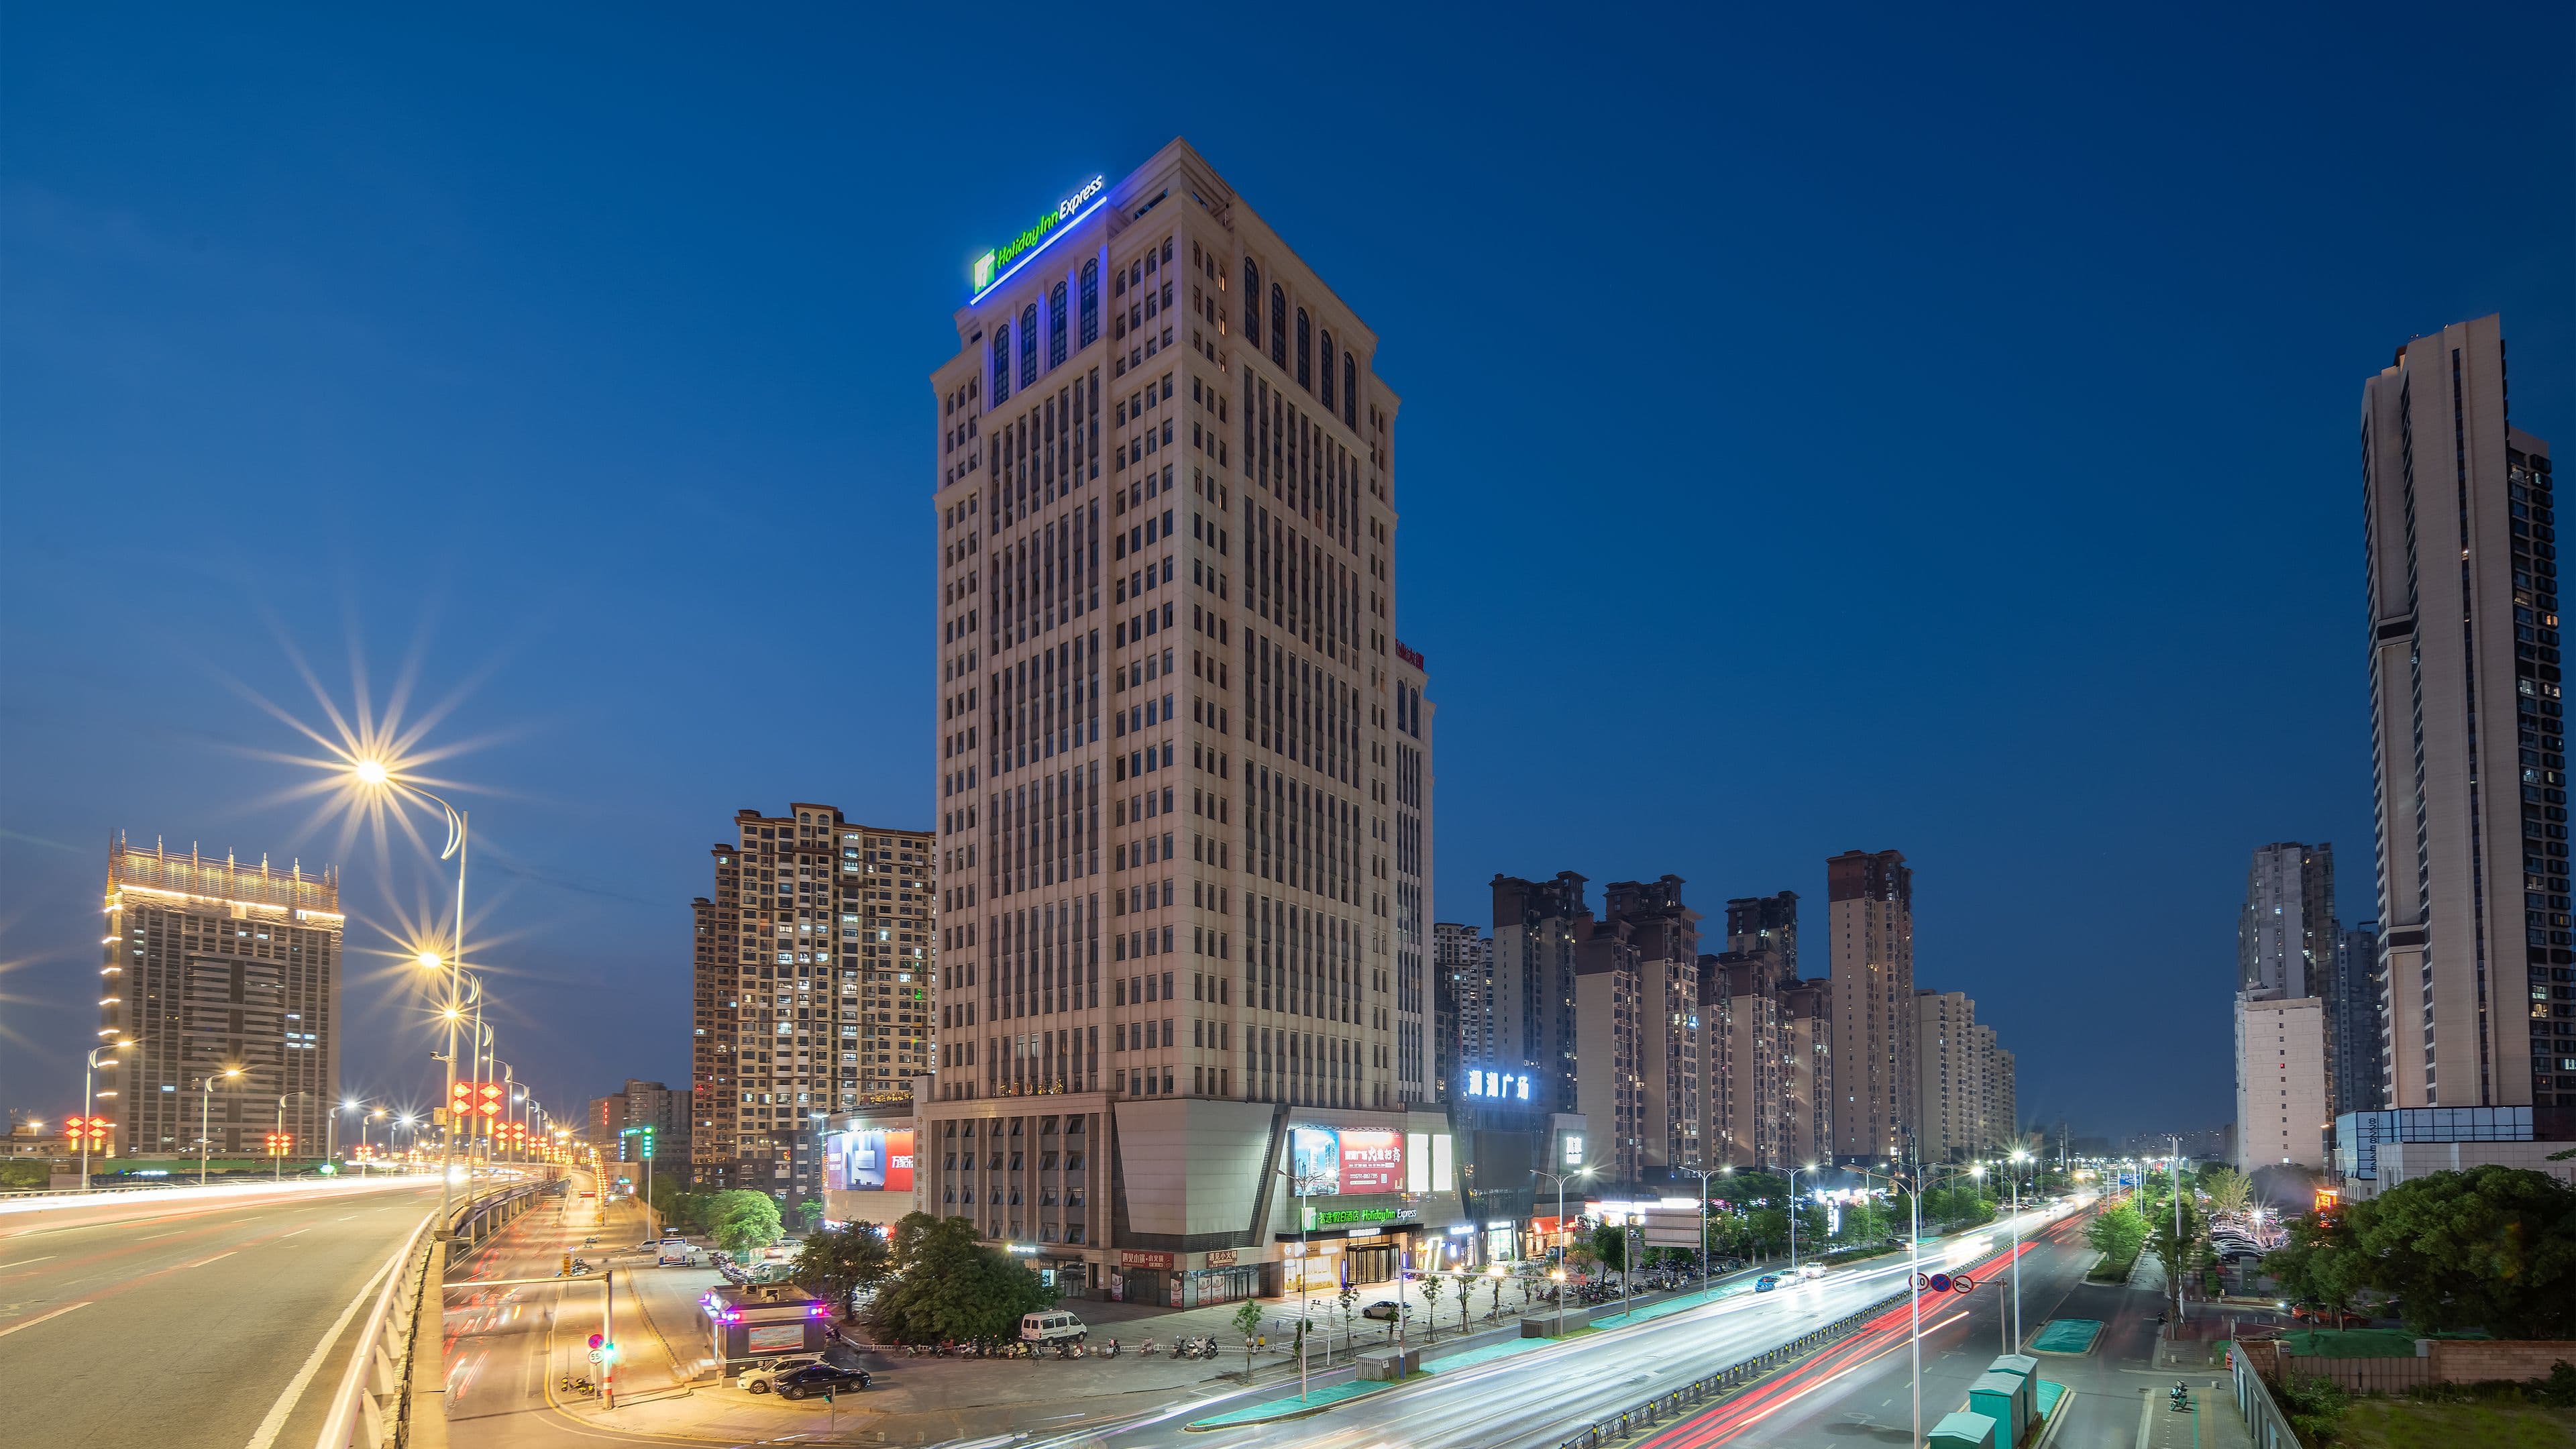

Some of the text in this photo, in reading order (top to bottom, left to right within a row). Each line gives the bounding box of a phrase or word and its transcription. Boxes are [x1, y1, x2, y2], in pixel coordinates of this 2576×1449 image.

[997, 174, 1102, 269] Holiday Inn Express
[1318, 1210, 1359, 1224] 智选假日酒店
[1362, 1208, 1417, 1222] Holiday Inn Express
